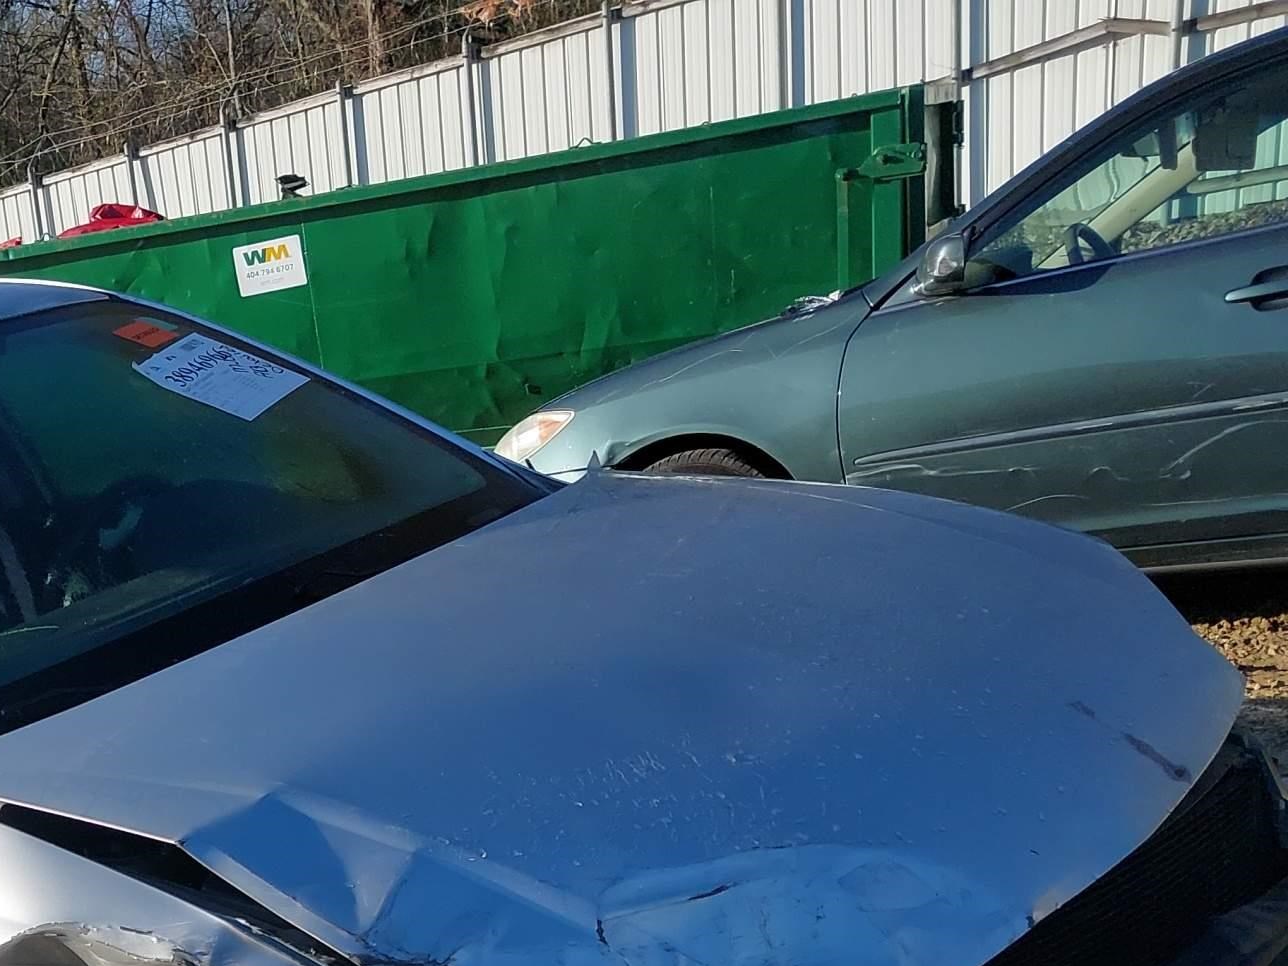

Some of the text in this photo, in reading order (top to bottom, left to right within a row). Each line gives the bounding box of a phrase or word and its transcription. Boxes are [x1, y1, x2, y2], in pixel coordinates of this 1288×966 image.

[242, 244, 290, 266] WM
[246, 271, 259, 279] 404
[164, 345, 233, 387] 38946966
